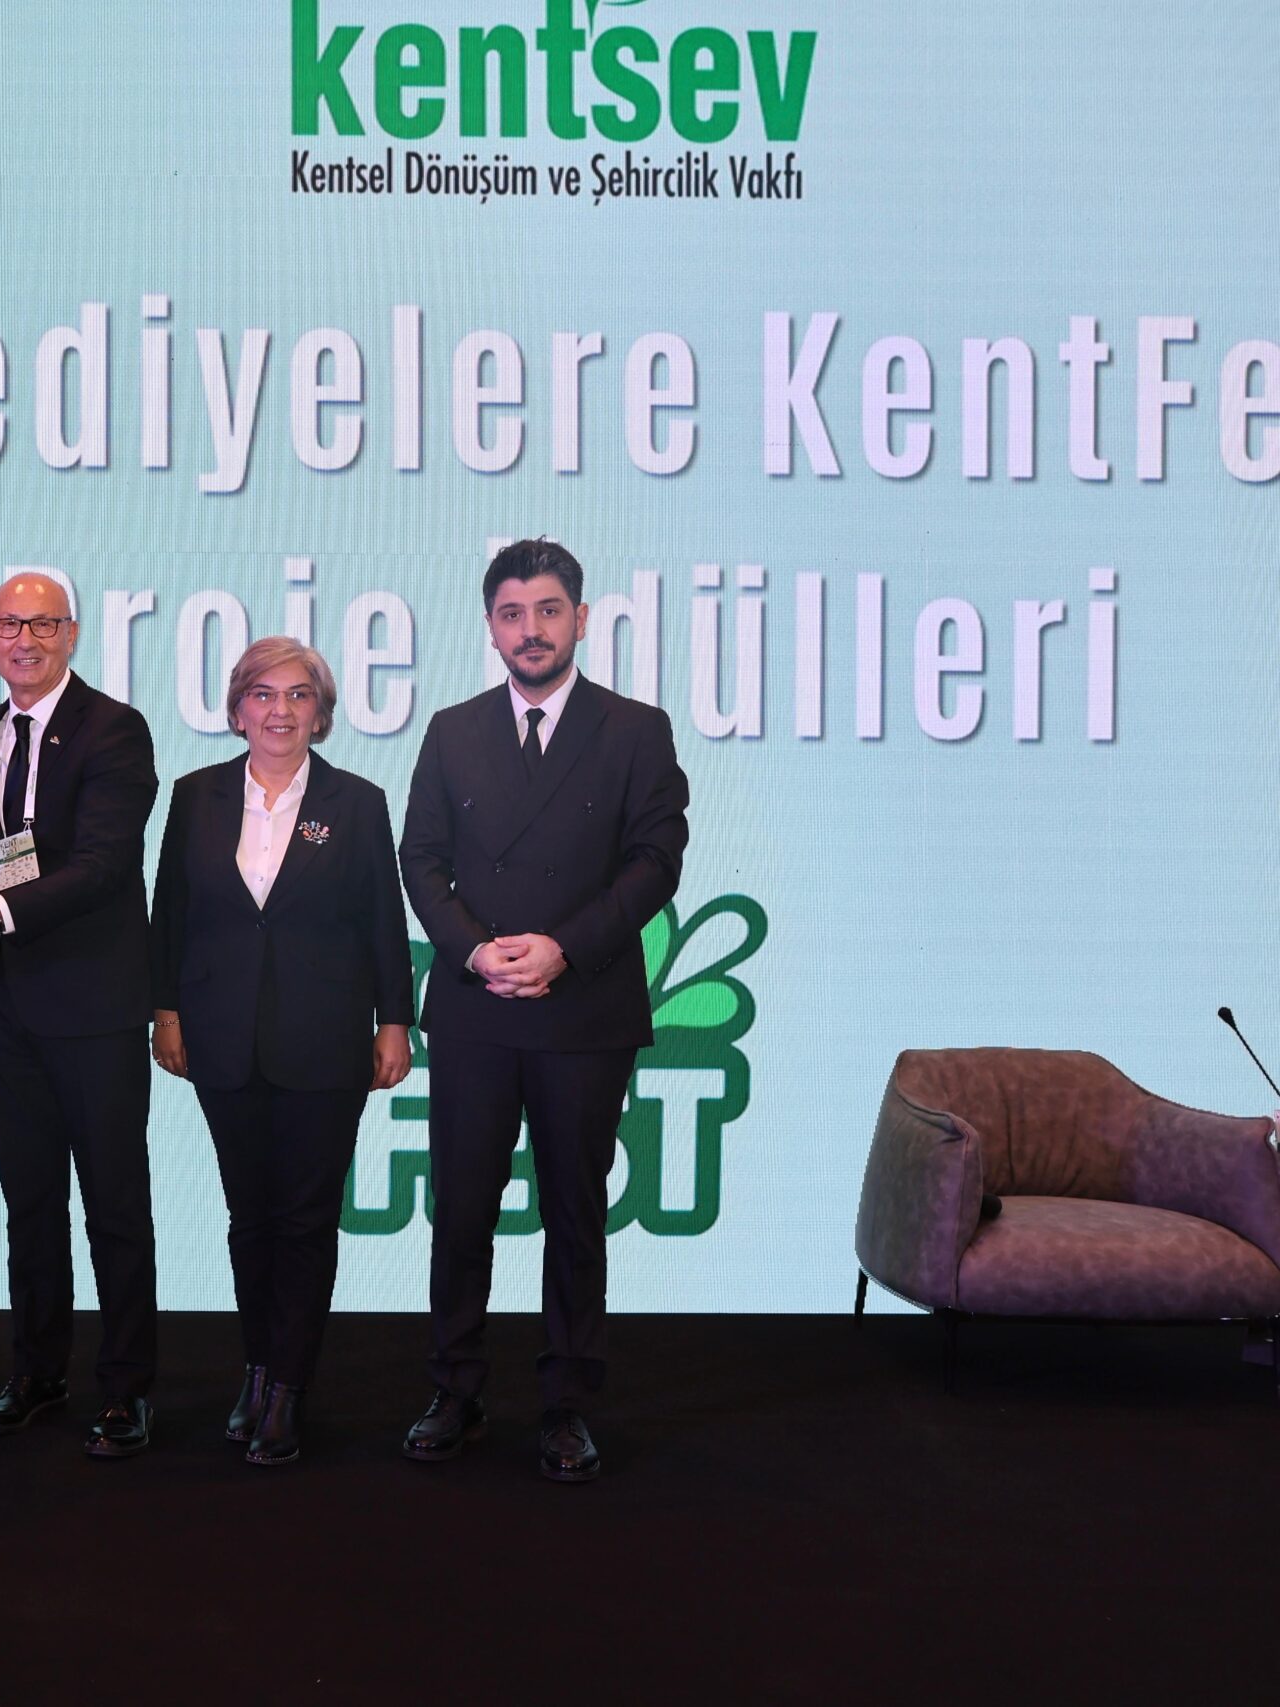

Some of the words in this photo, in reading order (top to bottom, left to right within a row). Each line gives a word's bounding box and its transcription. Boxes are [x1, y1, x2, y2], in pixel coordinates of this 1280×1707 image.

[291, 0, 817, 142] kentsev
[291, 147, 393, 195] Kentsel
[405, 152, 537, 204] Dönüşüm
[548, 164, 580, 196] ve
[592, 149, 719, 206] Şehircilik
[729, 153, 803, 200] Vakfı
[486, 536, 1118, 742] dülleri
